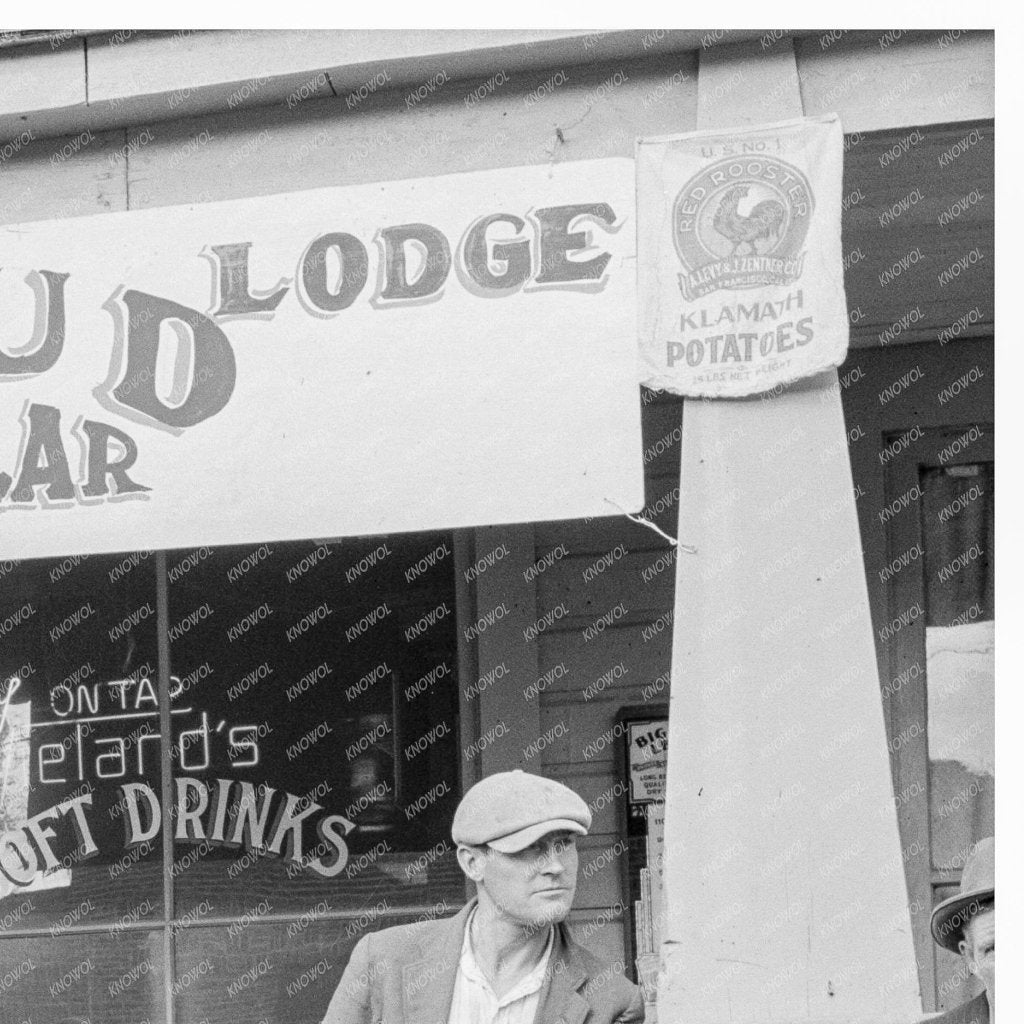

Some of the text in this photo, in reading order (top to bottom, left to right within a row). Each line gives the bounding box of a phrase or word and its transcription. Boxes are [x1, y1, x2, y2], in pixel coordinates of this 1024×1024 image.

[680, 162, 808, 233] RED ROOSTER
[197, 201, 627, 324] LODGE
[666, 315, 815, 368] POTATOES
[680, 289, 804, 332] KLAMATH
[49, 676, 183, 717] ON TAP
[116, 777, 357, 878] DRINKS
